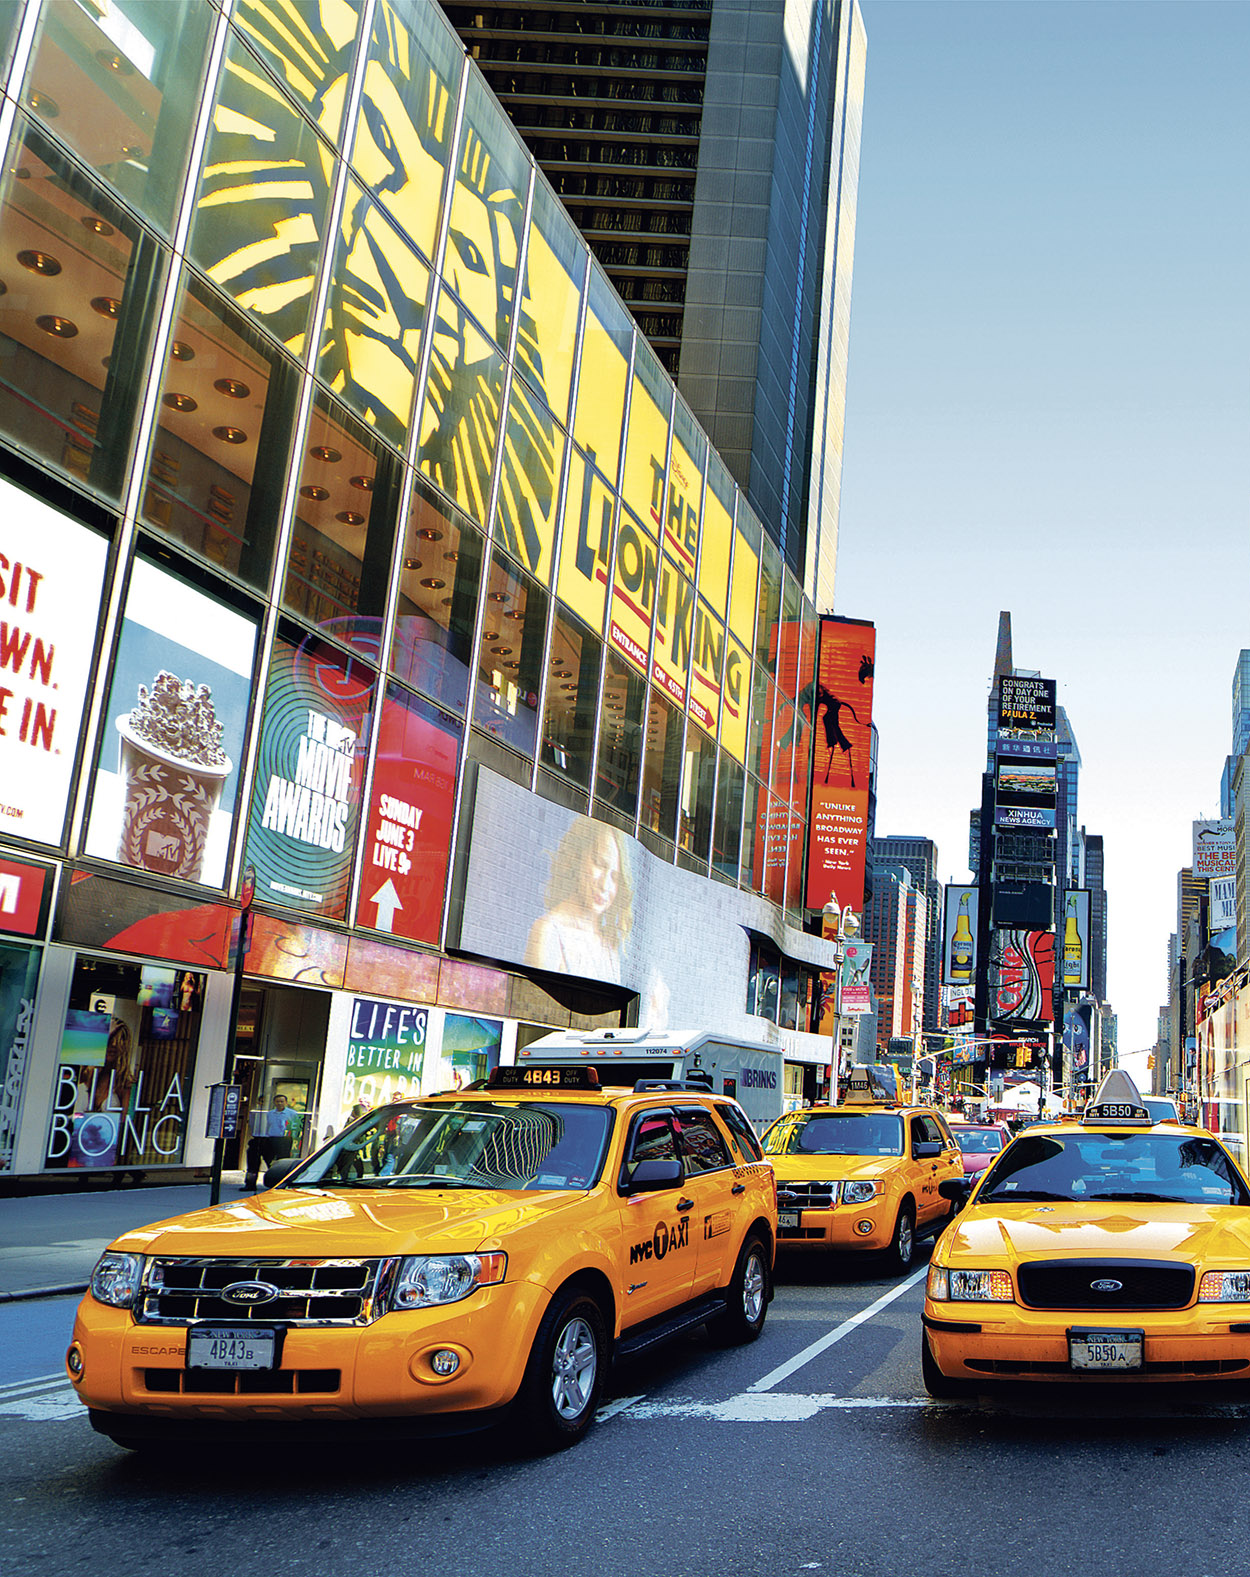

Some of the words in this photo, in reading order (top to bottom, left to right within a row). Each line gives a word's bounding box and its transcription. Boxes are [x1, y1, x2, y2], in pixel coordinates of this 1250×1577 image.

[650, 453, 698, 550] THE
[576, 443, 669, 629] LION
[671, 560, 743, 706] KING
[612, 625, 647, 666] ENTRANCE
[654, 667, 666, 683] ON
[667, 678, 684, 699] 45TH
[689, 700, 707, 721] STREET
[1002, 679, 1045, 690] CONGRATS
[1002, 687, 1014, 695] ON
[1016, 688, 1032, 696] DAY
[1033, 689, 1049, 698] ONE
[1013, 695, 1036, 704] YOUR
[1001, 709, 1028, 719] PAULA
[295, 734, 355, 805] MOVIE
[261, 774, 349, 854] AWARDS
[379, 793, 424, 830] SUNDAY
[816, 813, 863, 824] ANYTHING
[999, 816, 1021, 824] NEWS
[1021, 817, 1051, 825] AGENCY
[1008, 809, 1043, 819] XINHUA
[376, 819, 406, 849] JUNE
[405, 830, 415, 852] 3
[816, 825, 863, 835] BROADWAY
[817, 836, 836, 844] HAS
[838, 837, 859, 846] EVER
[372, 842, 399, 872] LIVE
[953, 941, 971, 949] Corona
[350, 1001, 427, 1046] LIFE'S
[348, 1044, 400, 1072] BETTER
[407, 1052, 423, 1072] IN
[54, 1066, 184, 1112] BILLA
[746, 1068, 777, 1090] BRINKS
[1103, 1105, 1131, 1116] 5B50
[48, 1113, 183, 1159] BONG
[630, 1239, 653, 1266] NYC
[653, 1217, 690, 1261] TAXI
[231, 1287, 260, 1302] Ford
[1097, 1280, 1117, 1291] Ford
[131, 1345, 186, 1357] ESCAPE
